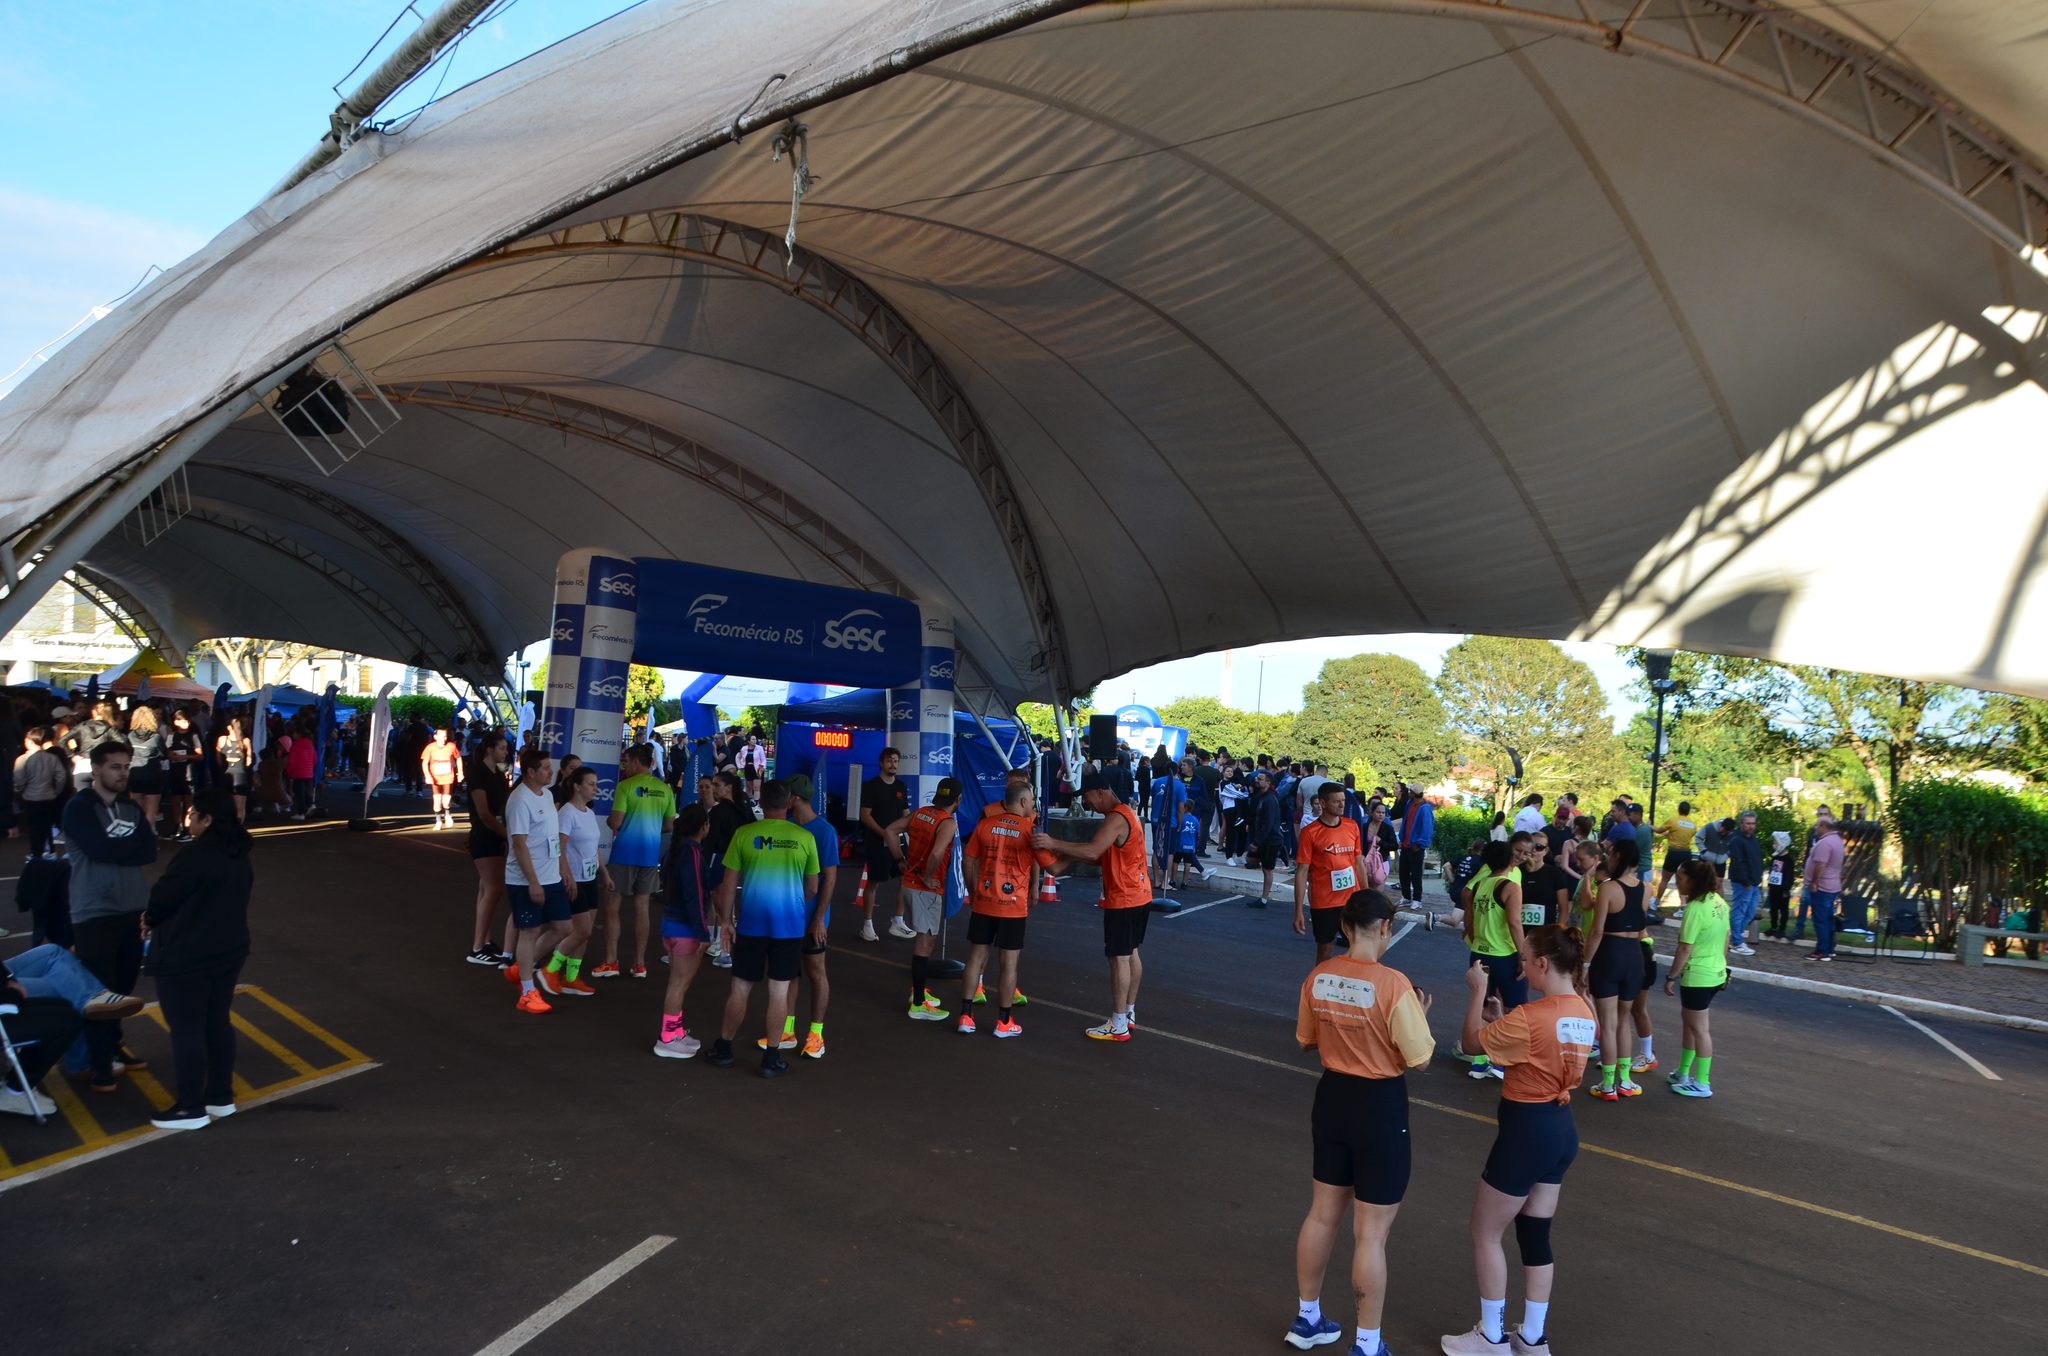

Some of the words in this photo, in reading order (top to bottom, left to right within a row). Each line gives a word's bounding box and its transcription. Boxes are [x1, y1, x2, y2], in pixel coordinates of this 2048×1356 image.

[598, 575, 635, 598] Sesc
[694, 617, 781, 643] Fecomércio
[784, 628, 804, 645] RS
[822, 617, 887, 653] Sesc
[588, 679, 625, 699] Sesc
[991, 826, 1021, 839] ADRIANO
[1335, 874, 1353, 889] 331
